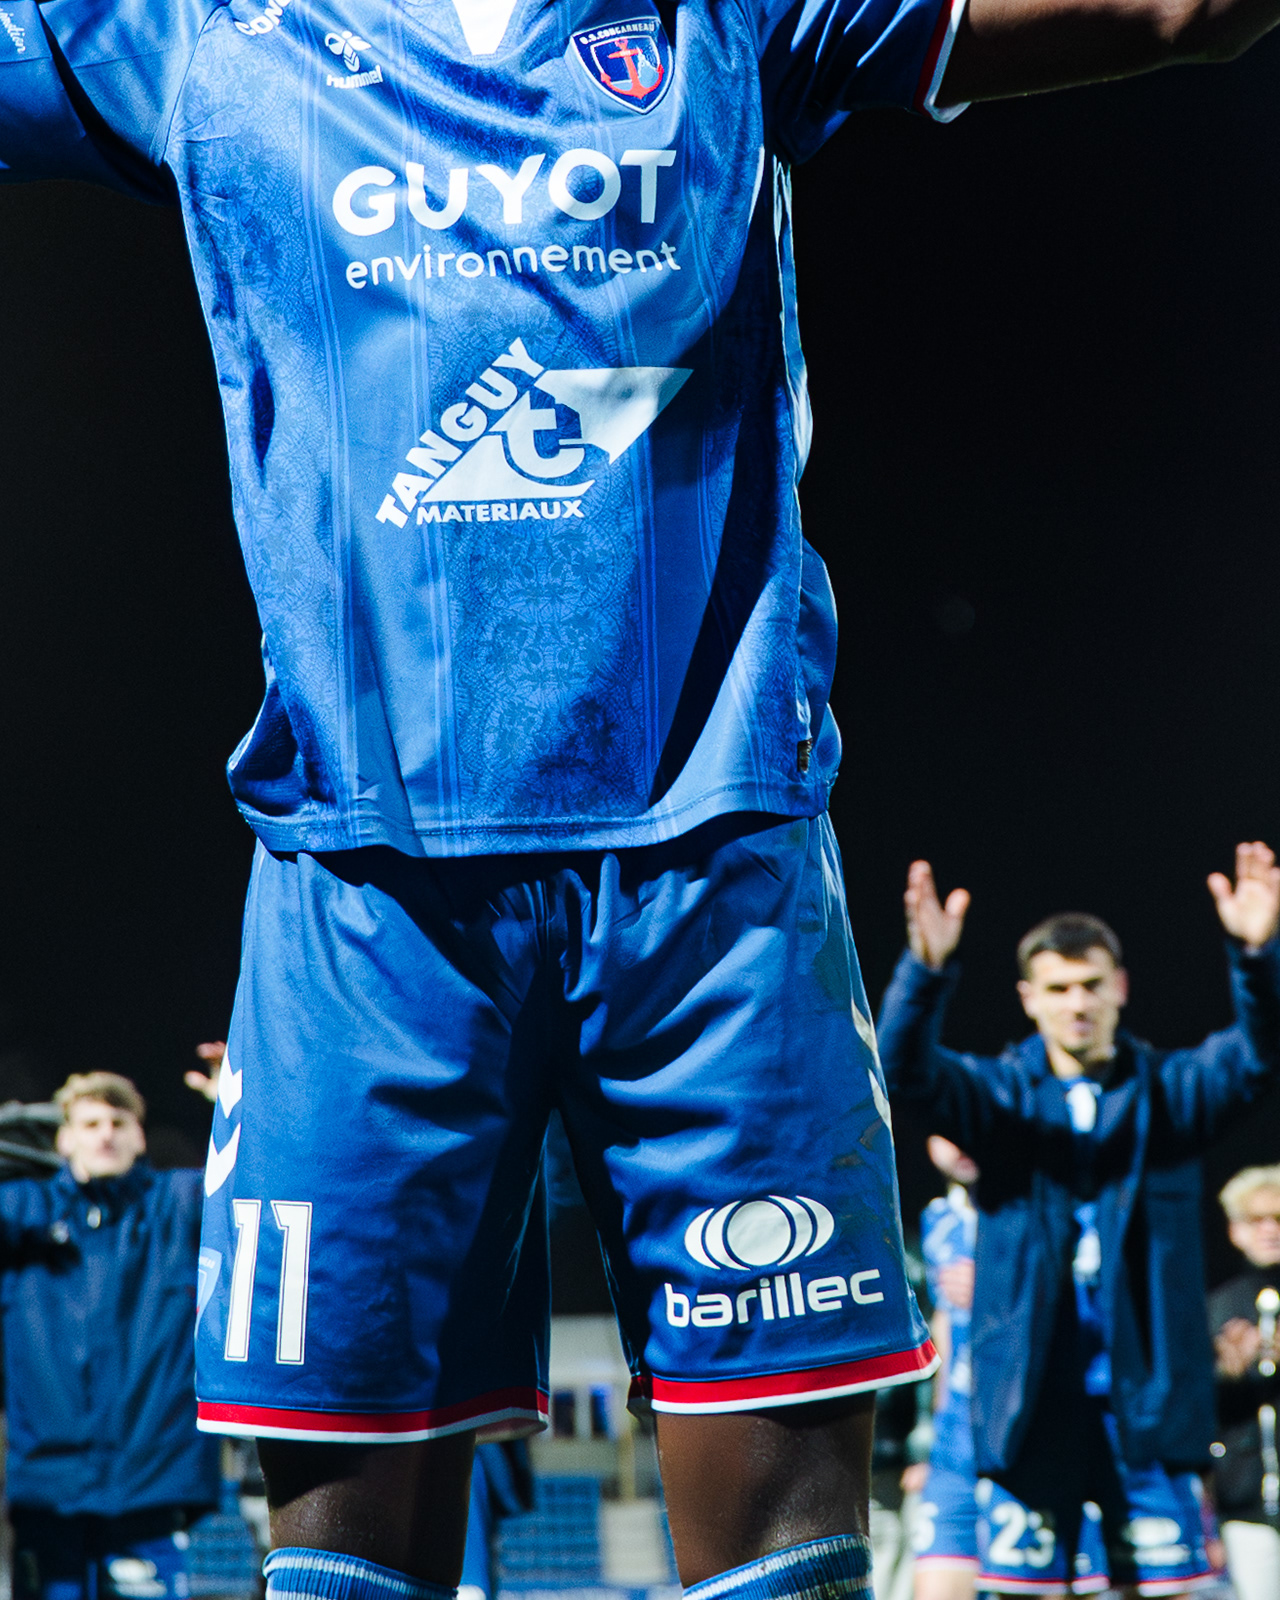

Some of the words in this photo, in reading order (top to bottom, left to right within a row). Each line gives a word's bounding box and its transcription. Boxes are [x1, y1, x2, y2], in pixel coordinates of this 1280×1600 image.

[326, 64, 384, 89] hummel
[332, 148, 677, 236] GUYOT
[346, 241, 682, 289] environnement
[375, 337, 545, 529] TANGUY
[416, 500, 585, 525] MATERIAUX
[224, 1199, 313, 1366] 11
[664, 1269, 885, 1328] barillec
